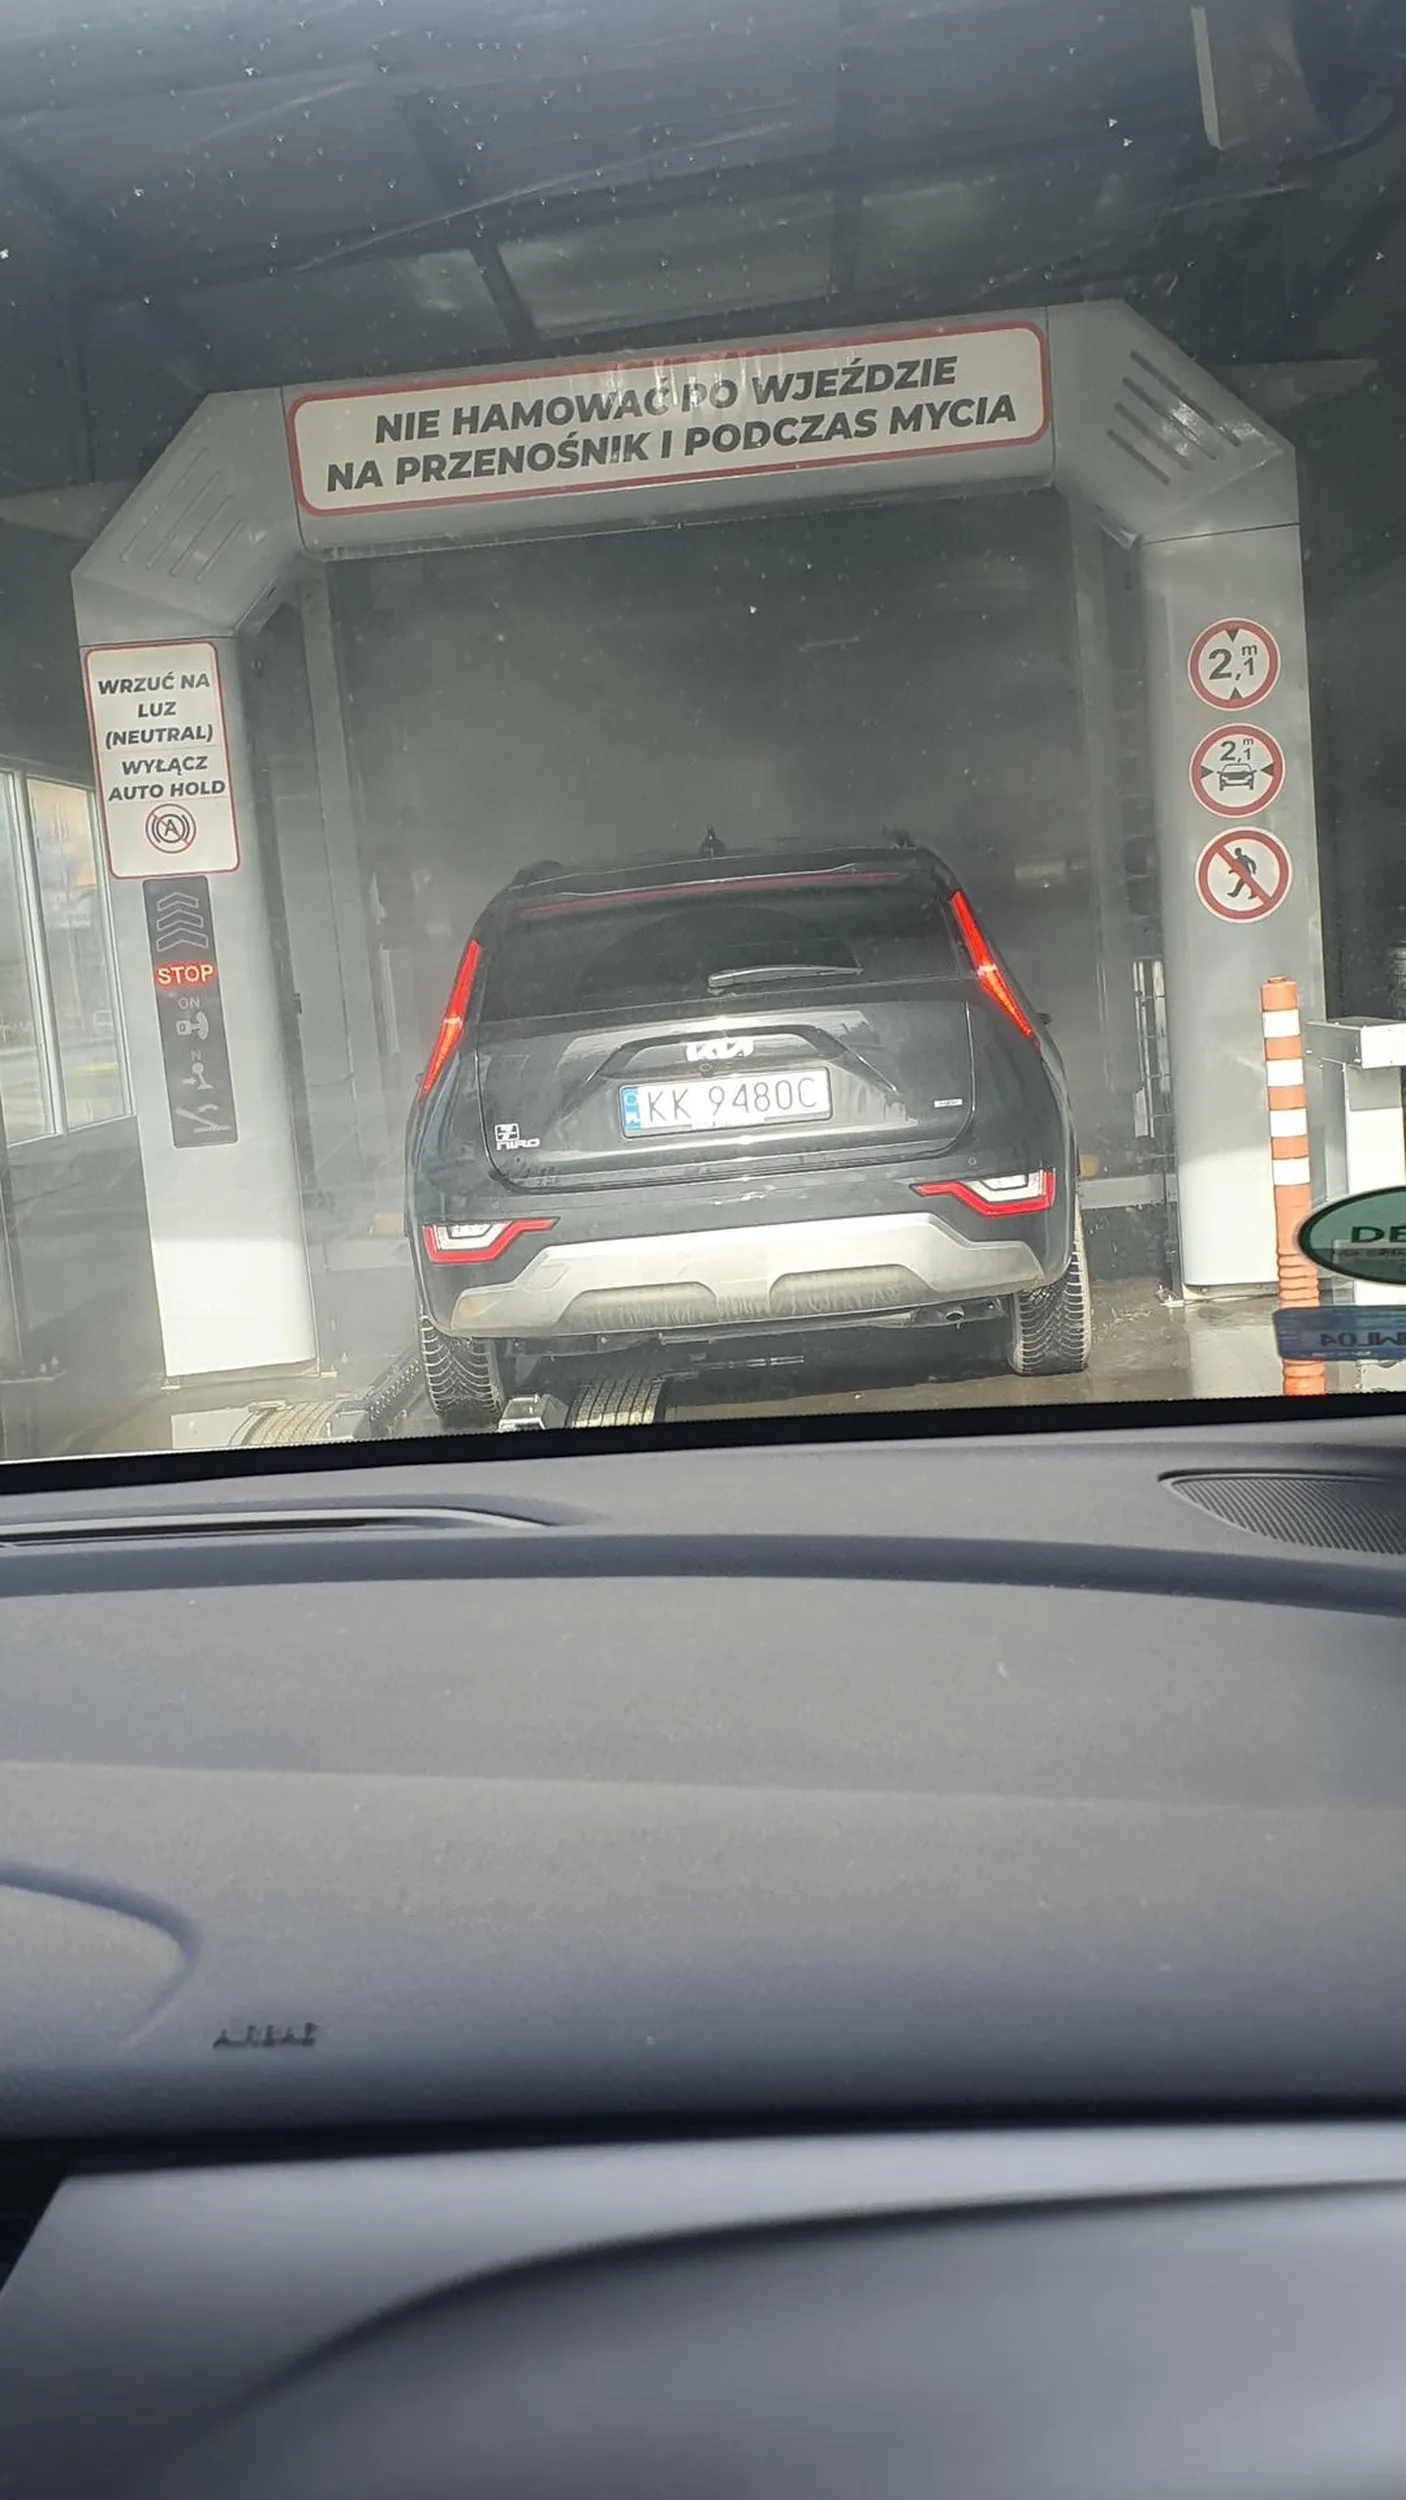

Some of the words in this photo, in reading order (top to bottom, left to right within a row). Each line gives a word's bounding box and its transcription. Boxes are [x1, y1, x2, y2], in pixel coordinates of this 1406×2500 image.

[376, 409, 440, 443] NIE
[453, 377, 670, 436] HAMOWAĆ
[681, 378, 738, 412] PO
[752, 356, 958, 405] WJEŹDZIE
[327, 460, 383, 492] NA
[396, 430, 651, 486] PRZENOŚNIK
[661, 430, 673, 459] I
[684, 408, 877, 457] PODCZAS
[889, 394, 1017, 435] MYCIA
[98, 672, 175, 695] WRZUĆ
[181, 673, 210, 689] NA
[138, 701, 177, 718] LUZ
[105, 724, 213, 750] (NEUTRAL)
[121, 756, 208, 776] WYŁĄCZ
[108, 783, 163, 801] AUTO
[170, 780, 226, 797] HOLD
[158, 963, 214, 985] STOP
[178, 996, 200, 1010] ON
[648, 1088, 692, 1122] KK
[708, 1077, 817, 1116] 9480C
